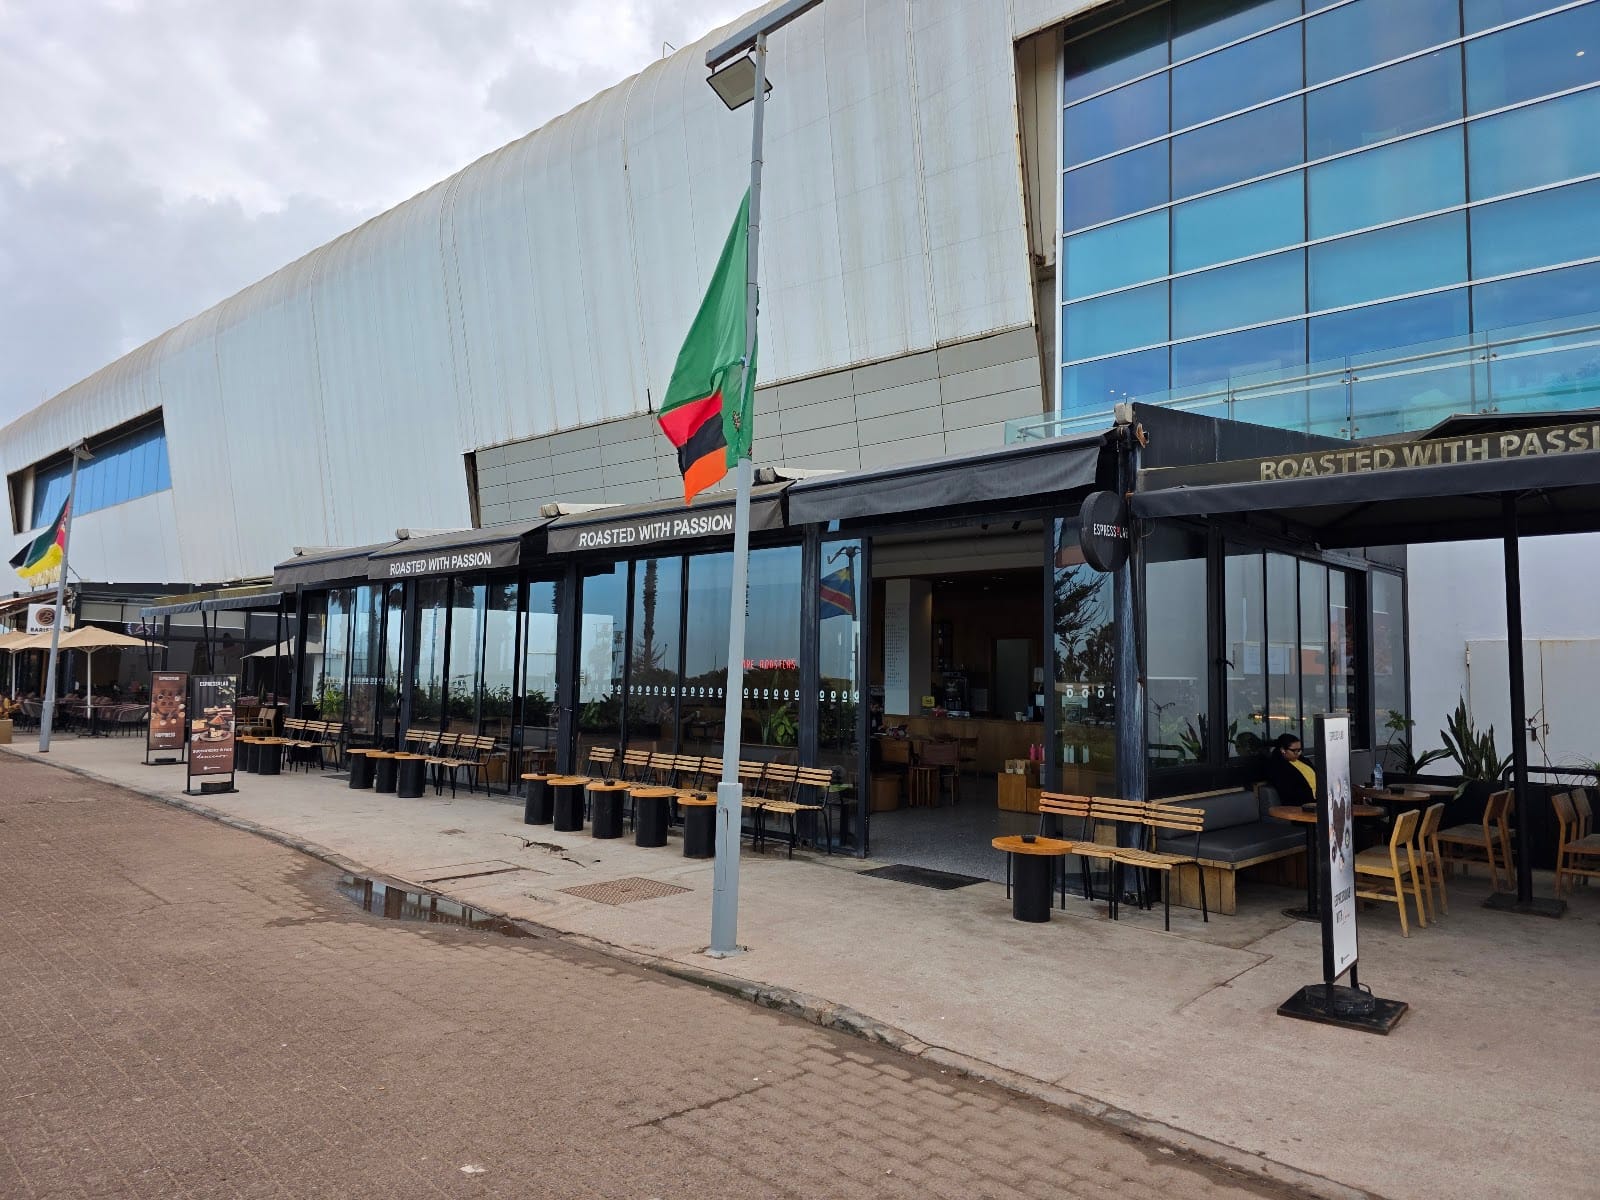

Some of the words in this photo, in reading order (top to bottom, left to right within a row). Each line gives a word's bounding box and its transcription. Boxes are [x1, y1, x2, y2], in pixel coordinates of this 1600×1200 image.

[1260, 448, 1396, 481] ROASTED
[1403, 437, 1489, 468] WITH
[578, 526, 636, 547] ROASTED
[638, 521, 670, 541] WITH
[673, 513, 733, 536] PASSION
[390, 559, 427, 576] ROASTED
[429, 555, 450, 571] WITH
[451, 551, 492, 569] PASSION
